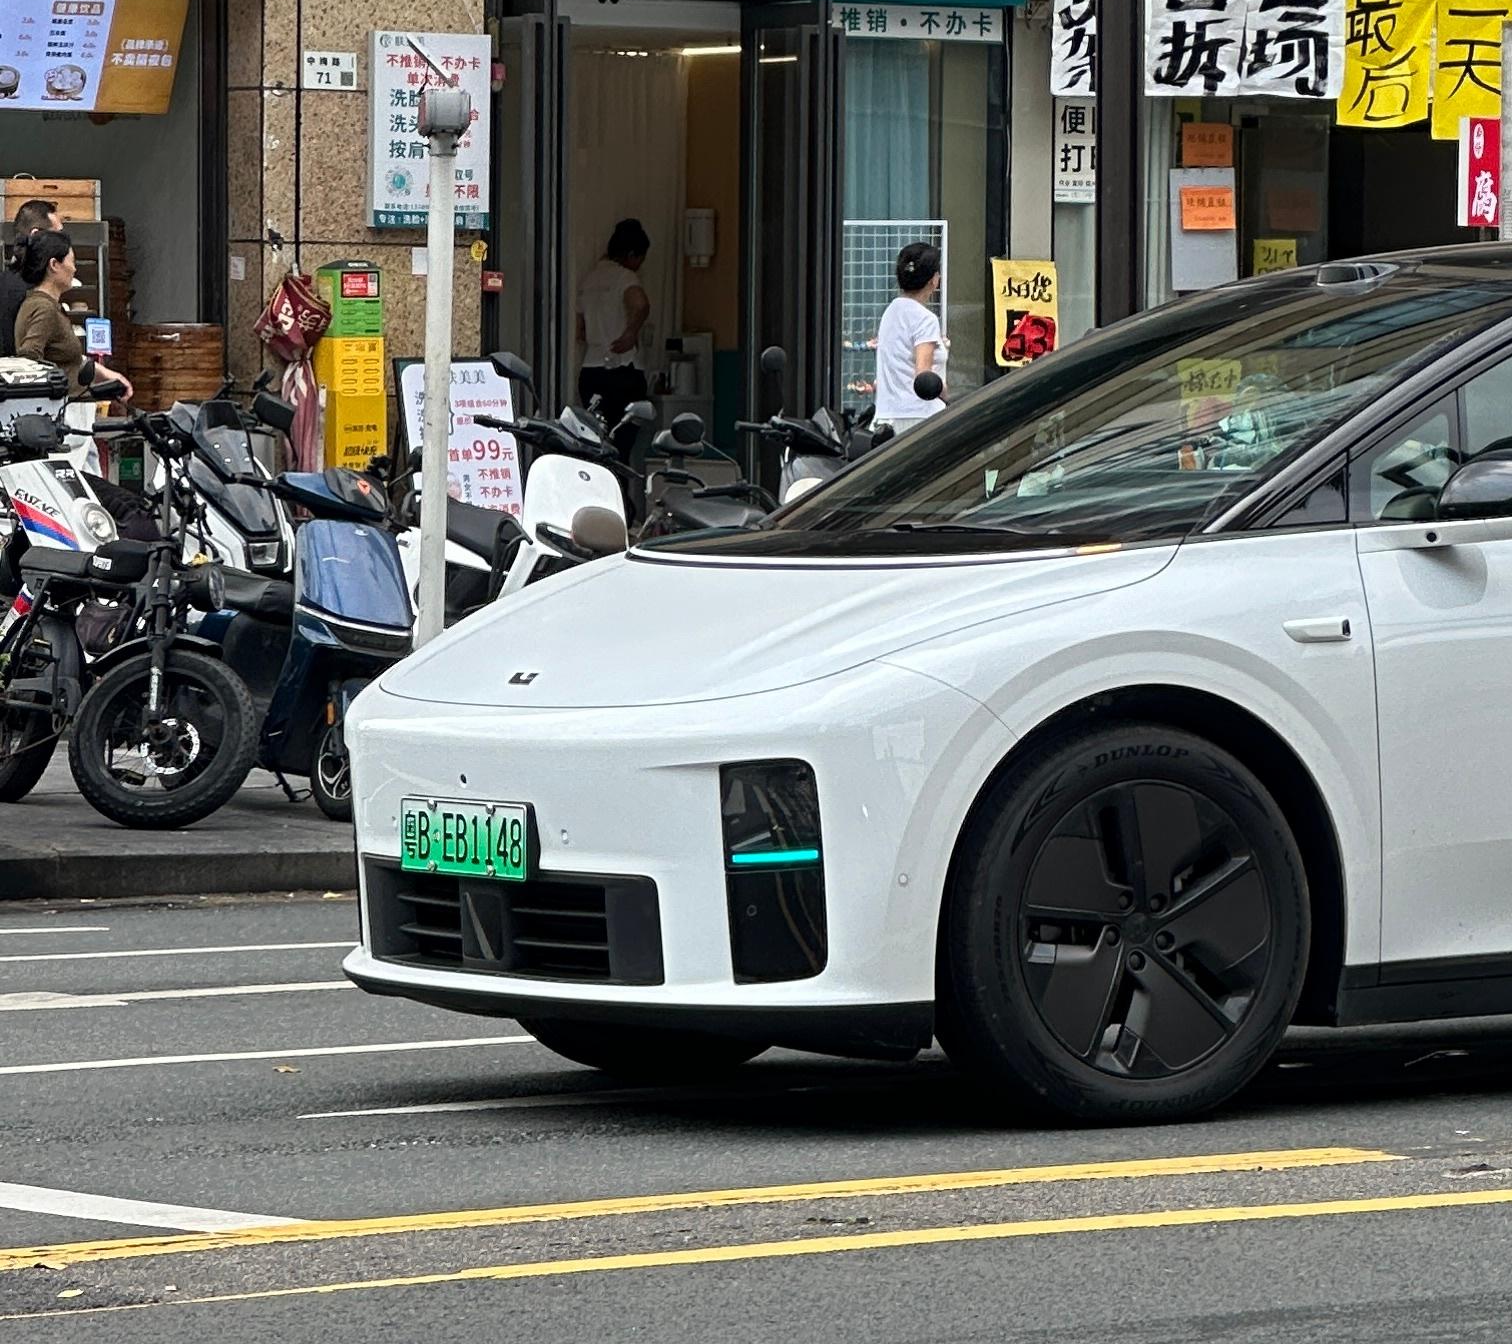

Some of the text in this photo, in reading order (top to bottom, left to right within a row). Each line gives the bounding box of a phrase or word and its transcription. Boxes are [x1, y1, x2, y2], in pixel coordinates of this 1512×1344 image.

[441, 55, 482, 71] 不办卡
[316, 71, 332, 84] 71
[1061, 105, 1096, 135] 便
[1061, 143, 1096, 173] 打
[55, 468, 77, 479] RR
[1094, 744, 1190, 769] DUNLOP
